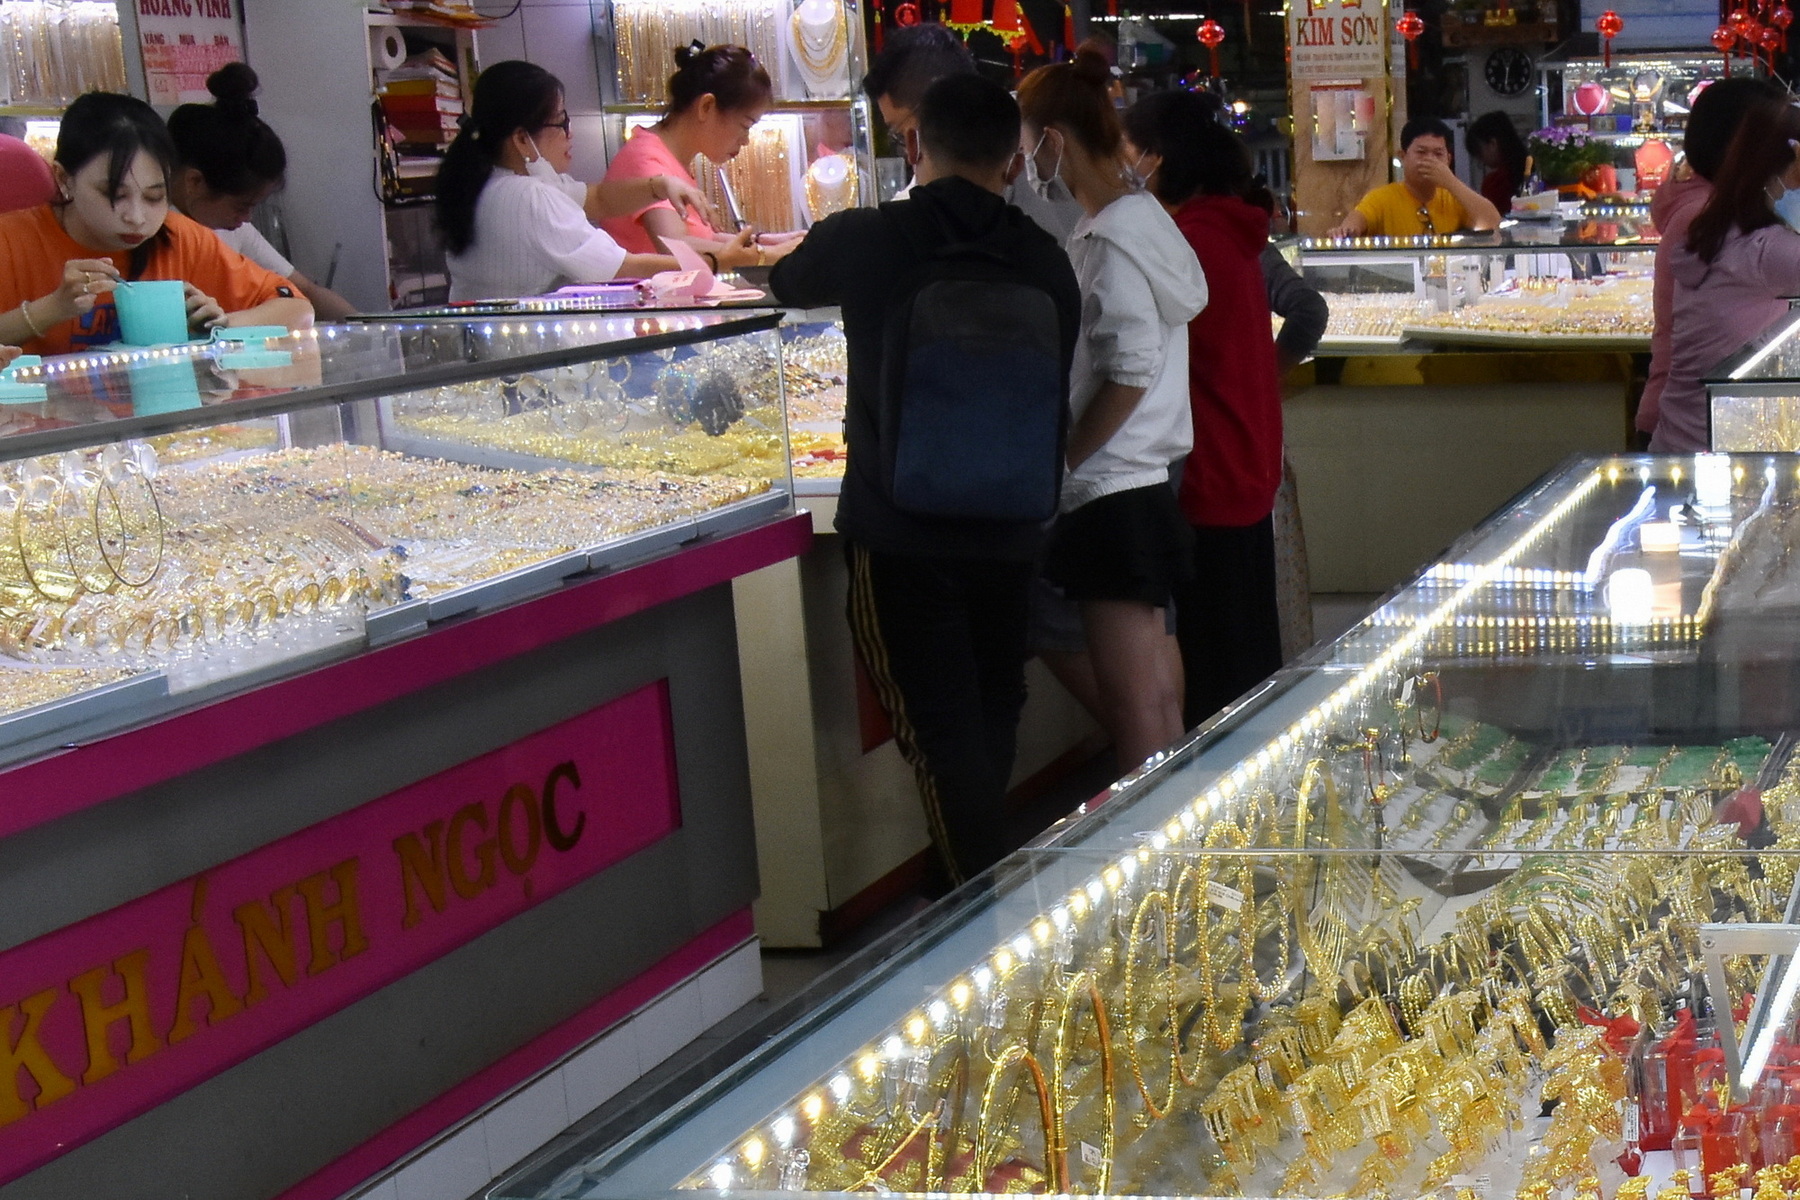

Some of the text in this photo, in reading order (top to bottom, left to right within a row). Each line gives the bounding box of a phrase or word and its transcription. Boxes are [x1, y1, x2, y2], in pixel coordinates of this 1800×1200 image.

[1296, 17, 1335, 46] KIM
[1341, 11, 1379, 46] SƠN
[0, 760, 586, 1126] KHÁNH NGỌC
